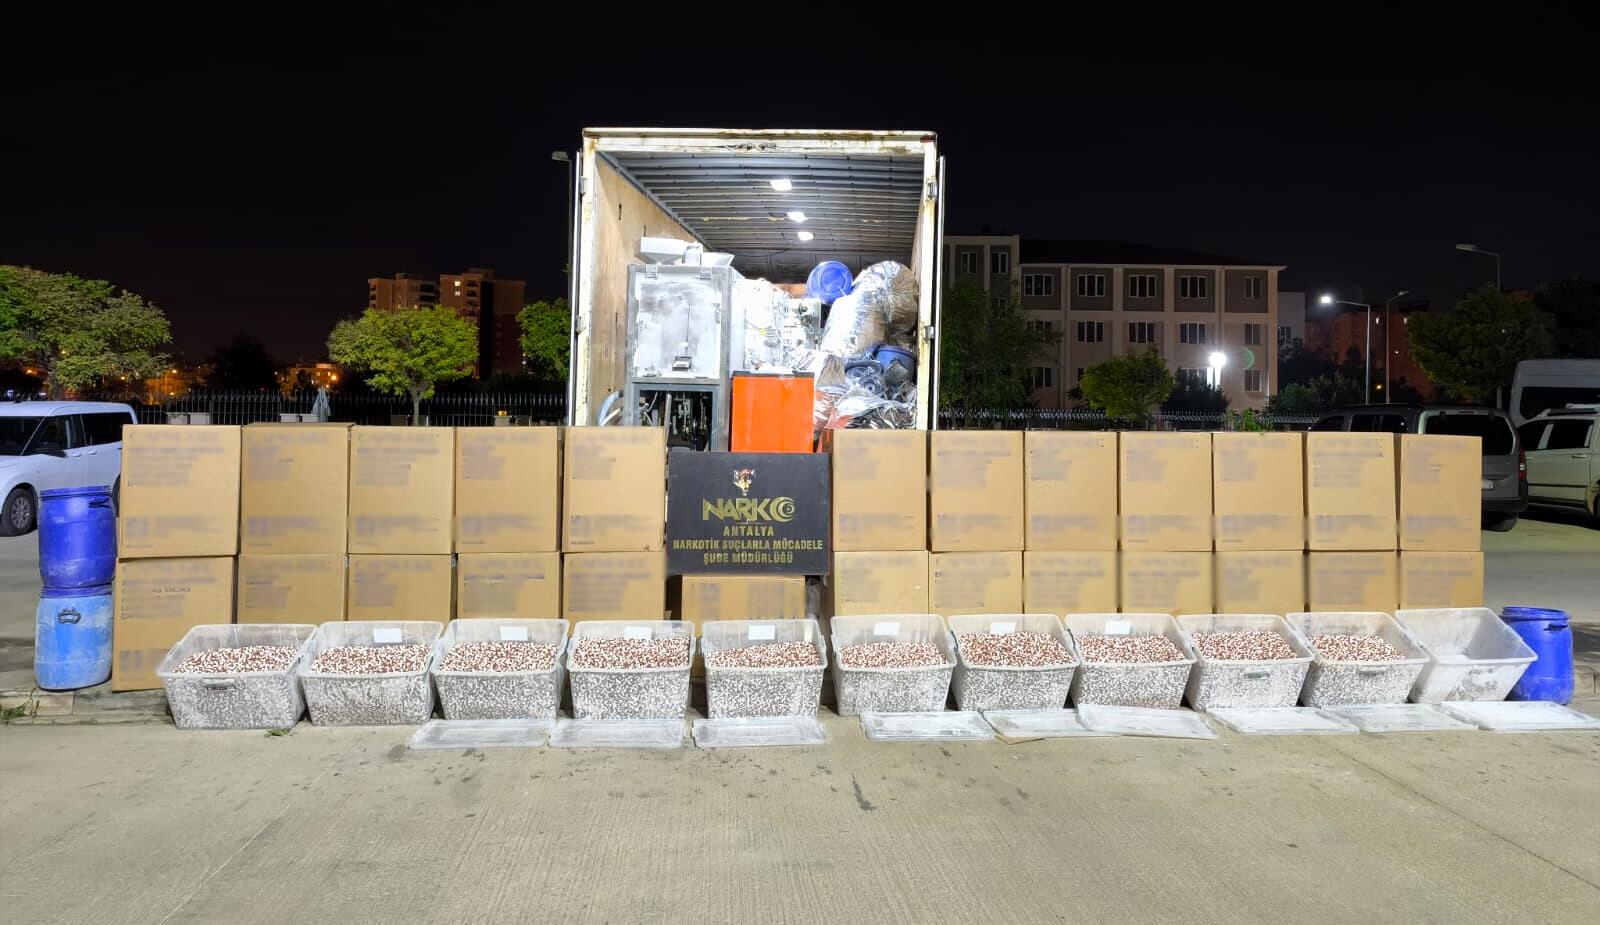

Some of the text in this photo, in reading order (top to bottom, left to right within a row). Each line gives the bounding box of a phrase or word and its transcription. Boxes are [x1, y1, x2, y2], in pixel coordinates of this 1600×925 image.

[723, 526, 774, 536] ANTALYA
[673, 538, 823, 552] NARKOTİK SUÇLARLA MÜCADELE
[703, 552, 793, 565] ŞUBE MÜDÜRLÜĞÜ
